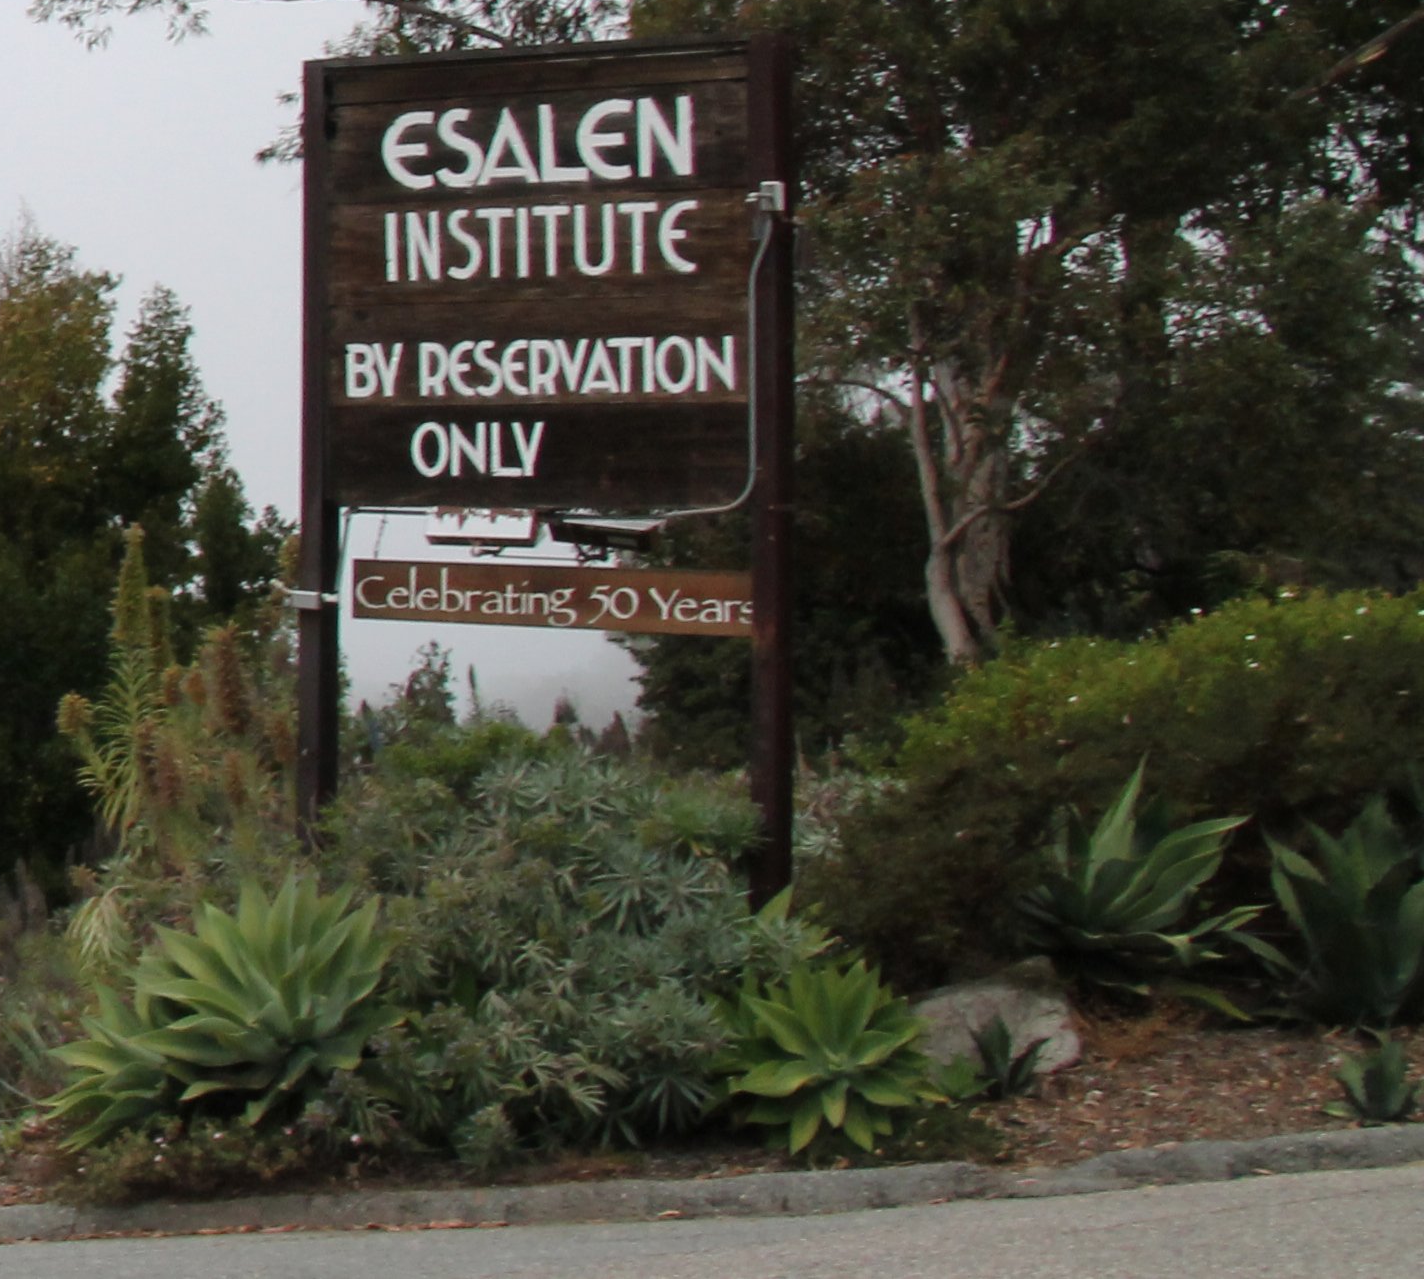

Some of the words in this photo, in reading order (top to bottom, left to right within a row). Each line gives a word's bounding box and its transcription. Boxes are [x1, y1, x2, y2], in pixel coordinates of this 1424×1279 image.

[381, 95, 695, 190] ESALEN
[384, 200, 698, 282] INSTITUTE
[345, 342, 404, 398] BY
[418, 335, 736, 397] RESERVATION
[410, 421, 545, 477] ONLY
[356, 565, 578, 627] Celebrating
[588, 584, 641, 624] 50
[648, 587, 754, 624] Years
